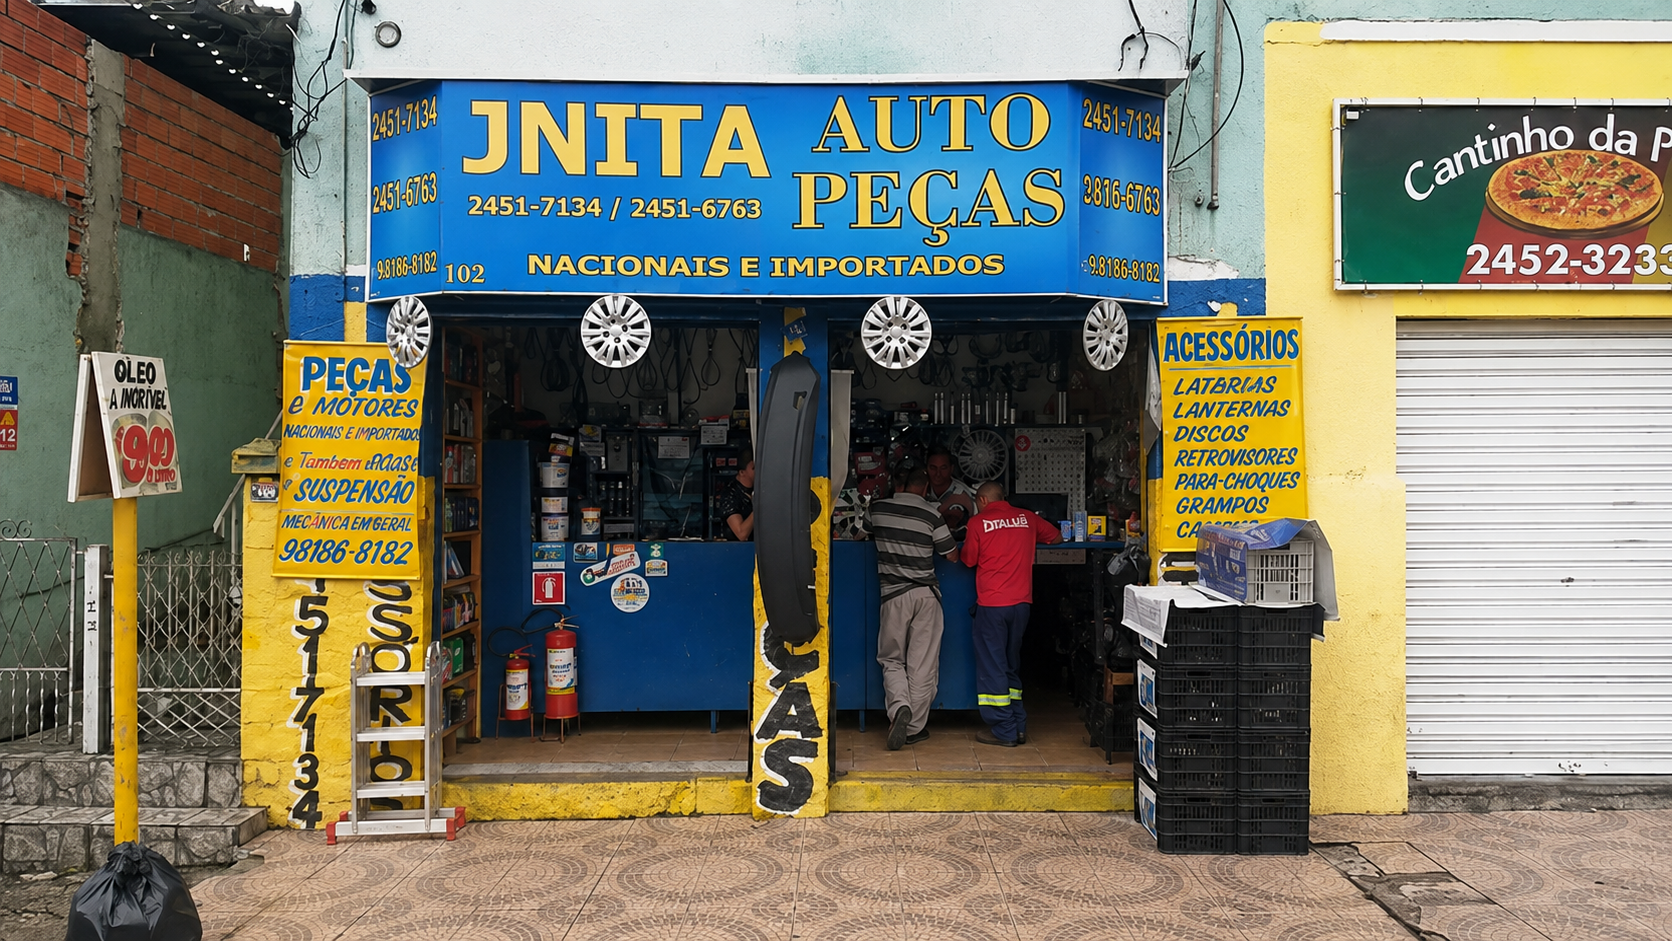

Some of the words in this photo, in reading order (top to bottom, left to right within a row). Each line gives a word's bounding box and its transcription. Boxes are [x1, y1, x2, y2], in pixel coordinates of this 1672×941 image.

[372, 95, 438, 141] 2451-7134
[811, 92, 1052, 154] AUTO
[1082, 98, 1162, 143] 2451-7134
[461, 99, 771, 179] JNITA
[1404, 115, 1575, 201] Cantinho
[1588, 113, 1638, 157] da
[372, 172, 438, 214] 2451-6763
[468, 195, 603, 217] 2451-7134
[609, 197, 622, 222] /
[630, 198, 763, 219] 2451-6763
[791, 168, 1066, 247] PEÇAS
[377, 251, 438, 280] 9.8186-8182
[445, 263, 486, 284] 102
[527, 254, 731, 278] NACIONAIS
[740, 257, 761, 278] E
[770, 254, 1006, 278] IMPORTADOS
[1088, 254, 1161, 283] 9.8186-8182
[1466, 243, 1672, 277] 2452-3233
[1163, 323, 1300, 362] ACESSÓRIOS
[301, 356, 412, 398] PEÇAS
[287, 395, 304, 415] e
[311, 396, 419, 418] MOTORES
[1173, 399, 1291, 419] LANTERNAS
[284, 423, 344, 440] NACIONAIS
[345, 426, 355, 440] E
[1173, 425, 1250, 443] DISCOS
[299, 451, 362, 470] Tambem
[1174, 447, 1299, 467] RETROVISORES
[293, 474, 416, 505] SUSPENSÃO
[1174, 471, 1301, 493] PARA-CHOQUES
[1176, 496, 1270, 514] GRAMPOS
[351, 515, 373, 531] EM
[373, 515, 412, 532] GERAL
[278, 538, 414, 566] 98186-8182
